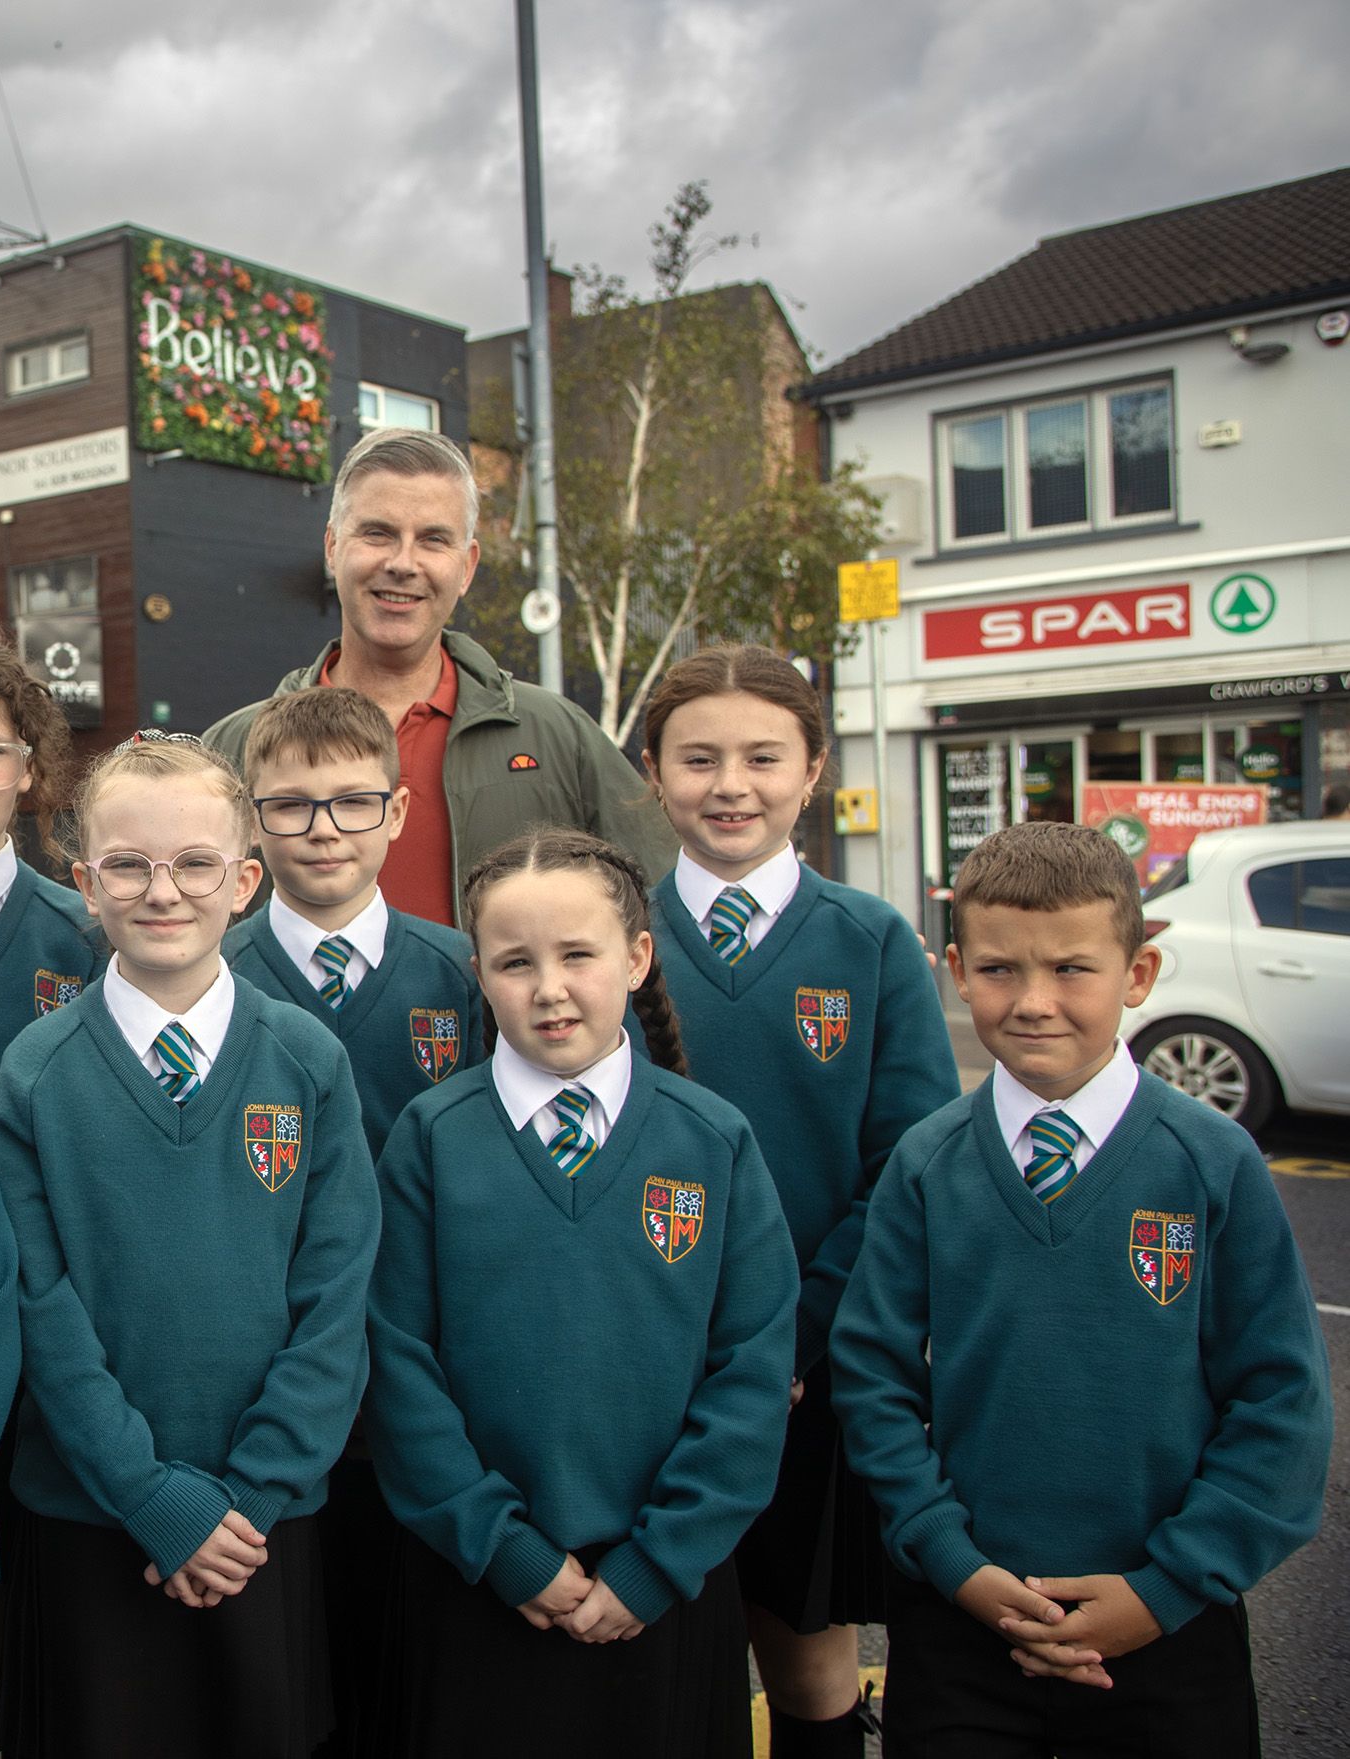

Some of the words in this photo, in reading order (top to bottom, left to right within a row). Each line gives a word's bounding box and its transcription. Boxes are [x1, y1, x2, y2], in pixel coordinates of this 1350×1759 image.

[147, 297, 317, 402] Believe
[979, 592, 1185, 648] SPAR
[1210, 675, 1330, 701] CRAWFORD'S
[1136, 792, 1194, 810] DEAL
[1197, 793, 1258, 812] ENDS
[825, 1021, 845, 1047] M
[435, 1040, 455, 1067] M
[244, 1103, 265, 1111] JOHN
[266, 1104, 283, 1112] PAUL
[275, 1143, 295, 1174] M
[1133, 1209, 1154, 1218] JOHN
[673, 1217, 696, 1246] M
[1167, 1254, 1191, 1286] M
